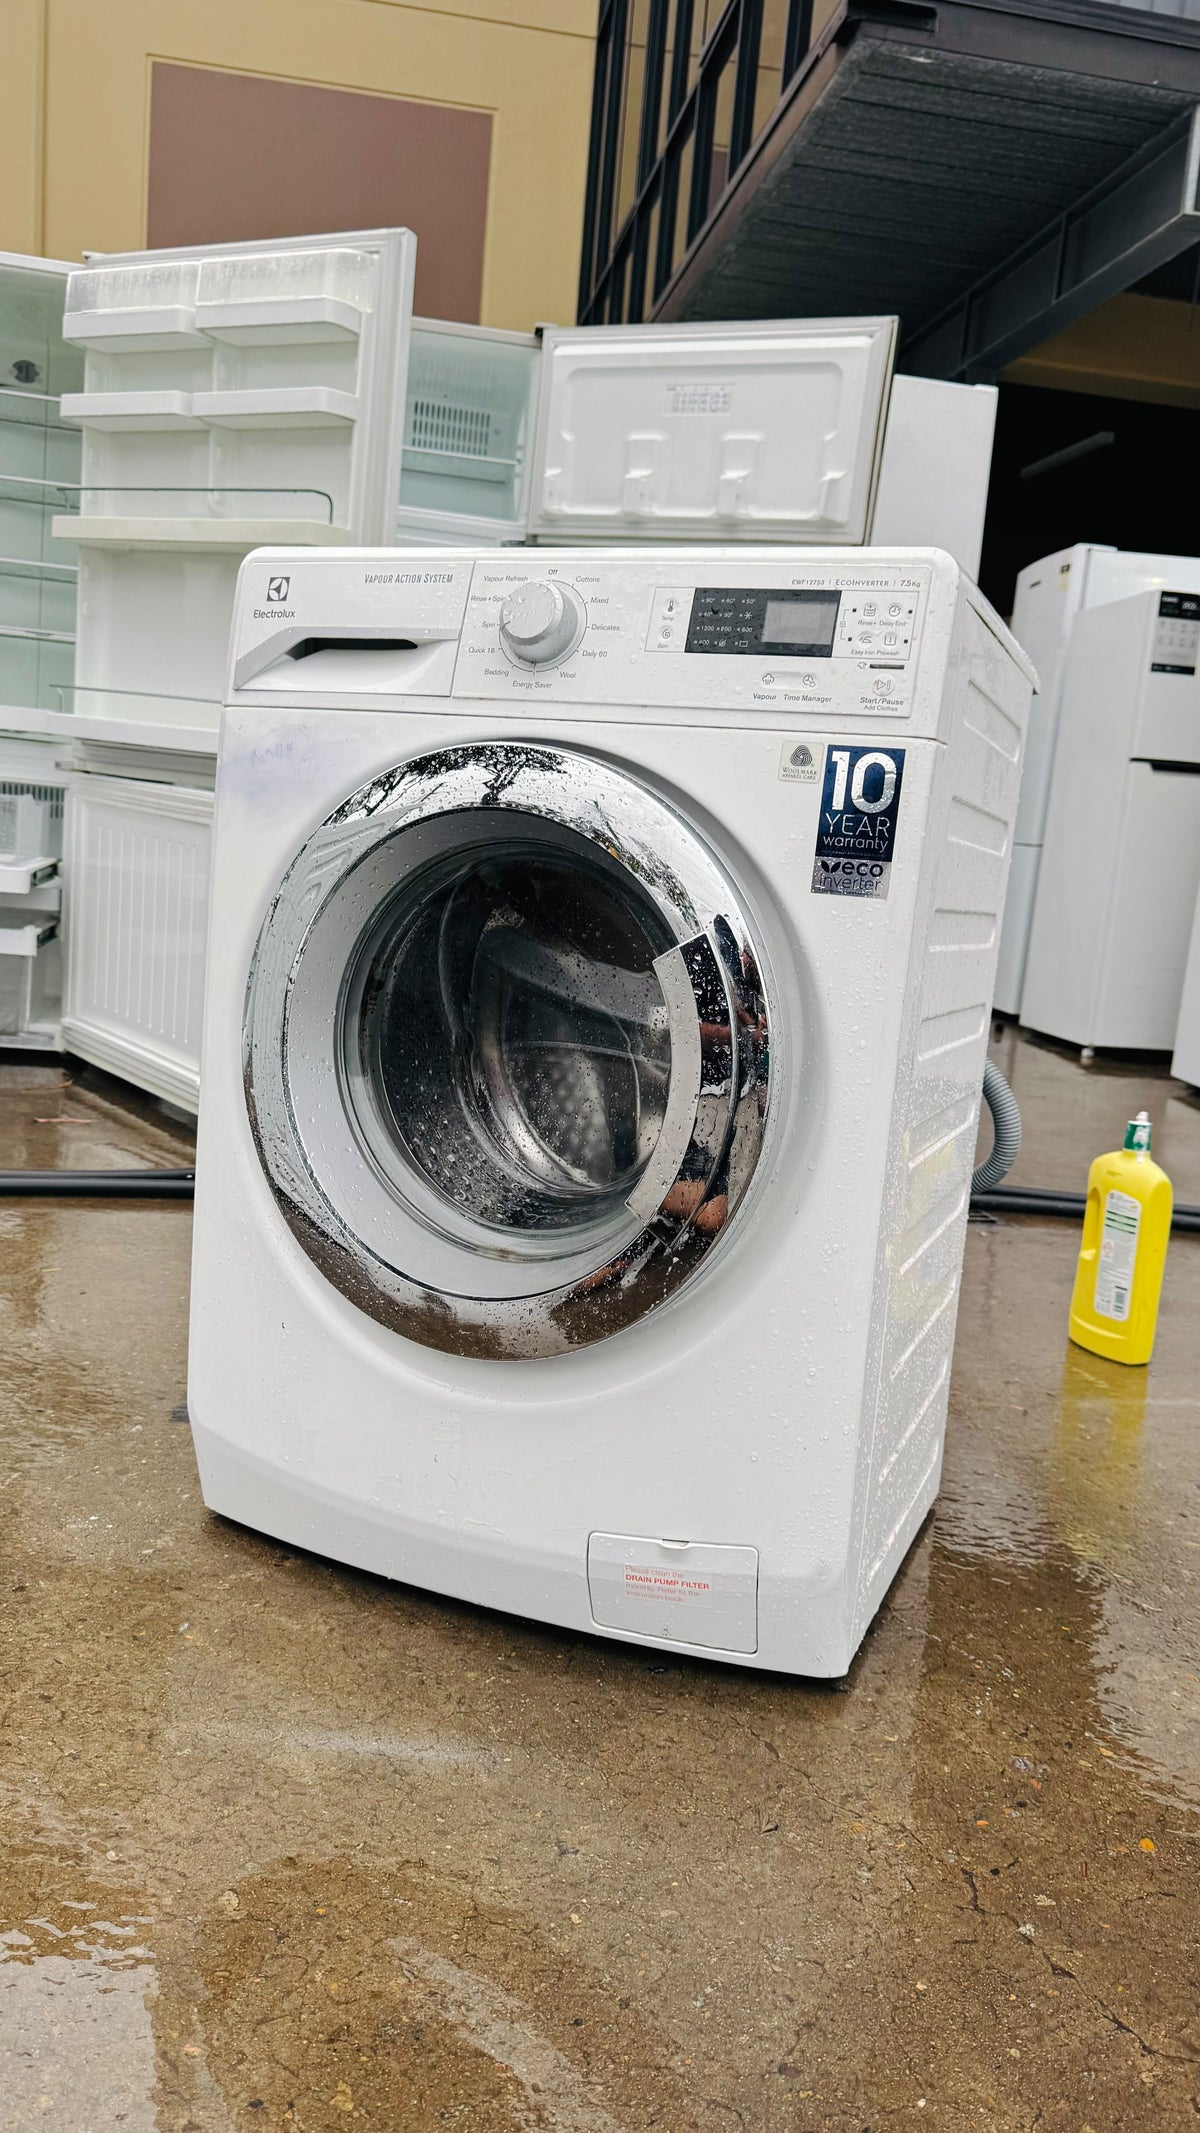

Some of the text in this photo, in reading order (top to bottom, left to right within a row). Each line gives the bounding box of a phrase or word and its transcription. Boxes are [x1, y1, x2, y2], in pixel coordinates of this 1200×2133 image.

[365, 573, 453, 584] VAPOUR ACTION SYSTEM
[253, 609, 296, 619] Electrolux
[582, 650, 597, 658] Daily
[484, 669, 509, 677] Bedding
[512, 681, 533, 689] Energy
[753, 693, 777, 701] Vapour
[802, 695, 832, 703] Manager
[860, 697, 904, 706] Start/Pause
[782, 767, 817, 775] WOOLMARK
[831, 750, 897, 814] 10
[825, 812, 891, 837] YEAR
[823, 836, 888, 853] warranty
[842, 861, 883, 877] eco
[819, 873, 881, 891] inverter
[625, 1565, 649, 1574] Please
[626, 1574, 651, 1583] DRAIN
[681, 1581, 709, 1589] FILTER
